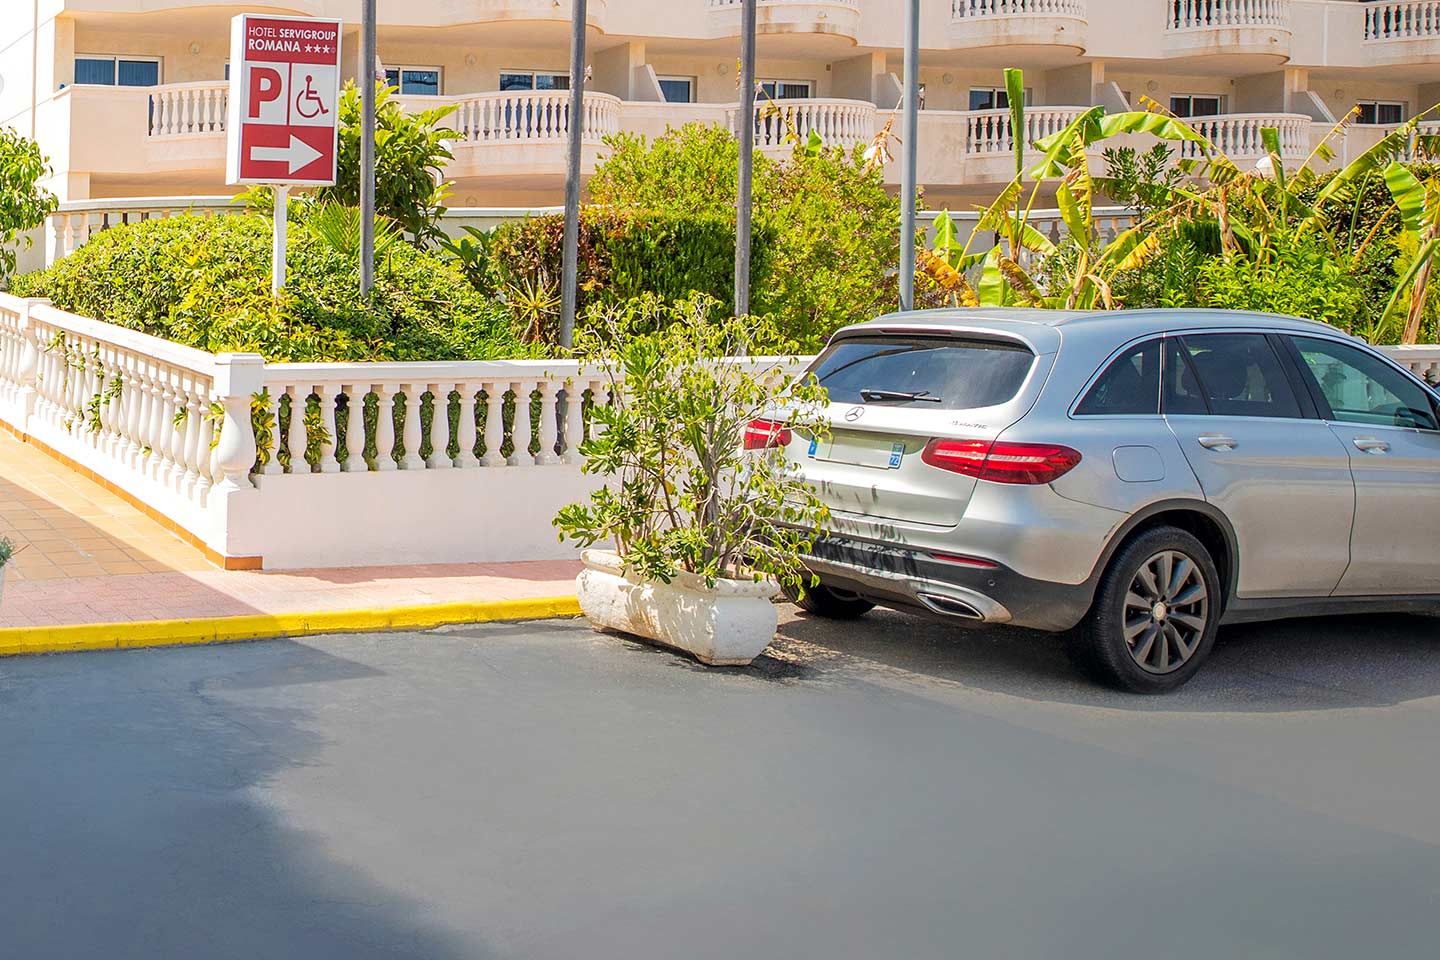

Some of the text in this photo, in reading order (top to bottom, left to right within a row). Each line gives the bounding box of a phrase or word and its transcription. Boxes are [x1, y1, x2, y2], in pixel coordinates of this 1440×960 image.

[248, 27, 336, 40] HOTEL SERVIGROUP
[248, 39, 301, 53] ROMANA
[248, 66, 282, 118] P
